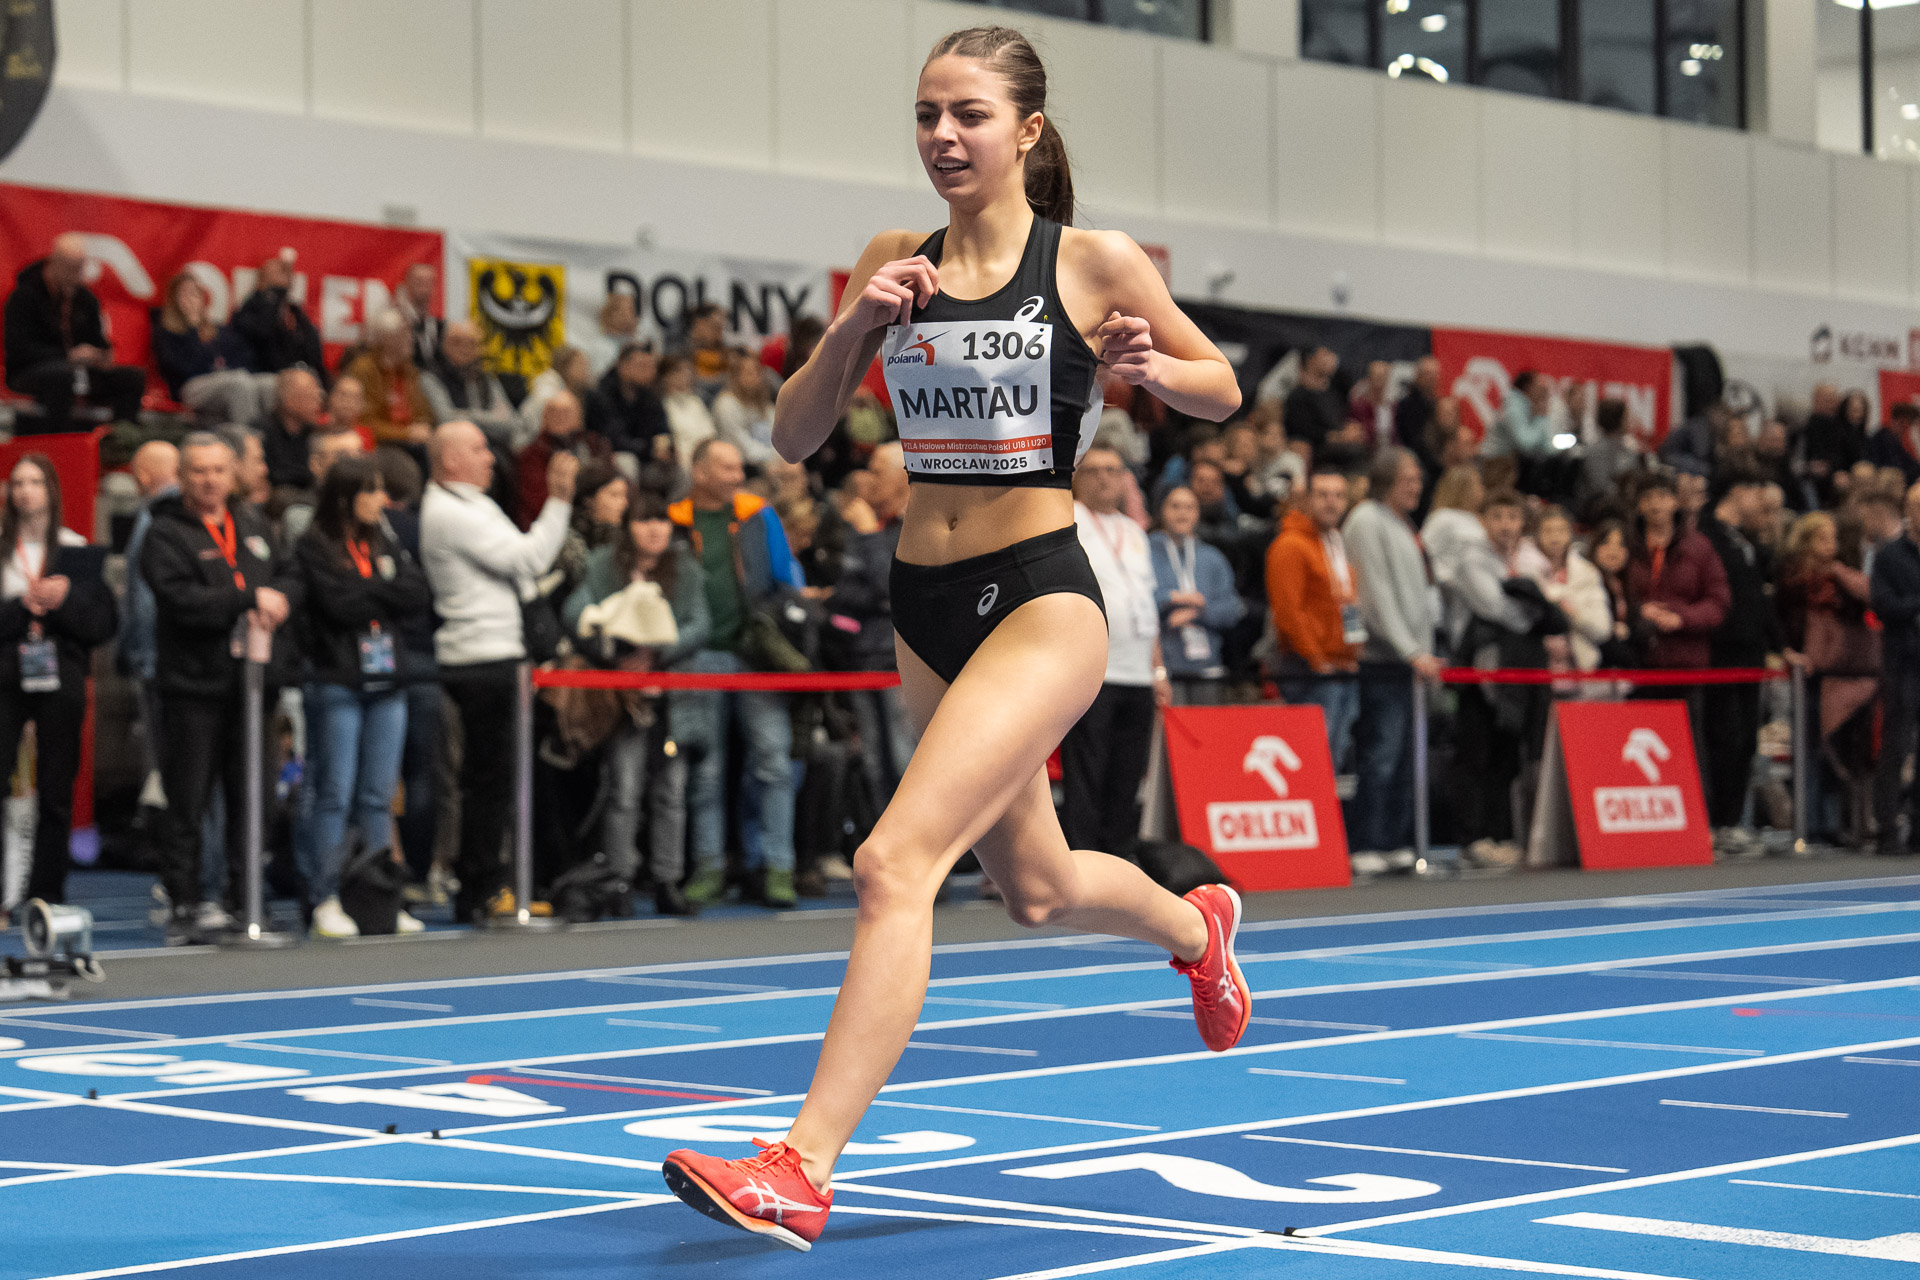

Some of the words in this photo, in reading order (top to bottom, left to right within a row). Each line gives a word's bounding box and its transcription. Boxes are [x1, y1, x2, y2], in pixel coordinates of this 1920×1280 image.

[962, 331, 1045, 361] 1306
[887, 353, 924, 366] polanik
[898, 384, 1039, 419] MARTAU
[919, 442, 946, 451] Halowe
[946, 442, 988, 451] Mistrzostwa
[988, 441, 1011, 451] Polski
[1012, 440, 1026, 450] U18
[1031, 437, 1047, 448] U20
[920, 457, 990, 470] WROCŁAW
[992, 456, 1028, 471] 2025
[1219, 810, 1307, 840] ORLEN
